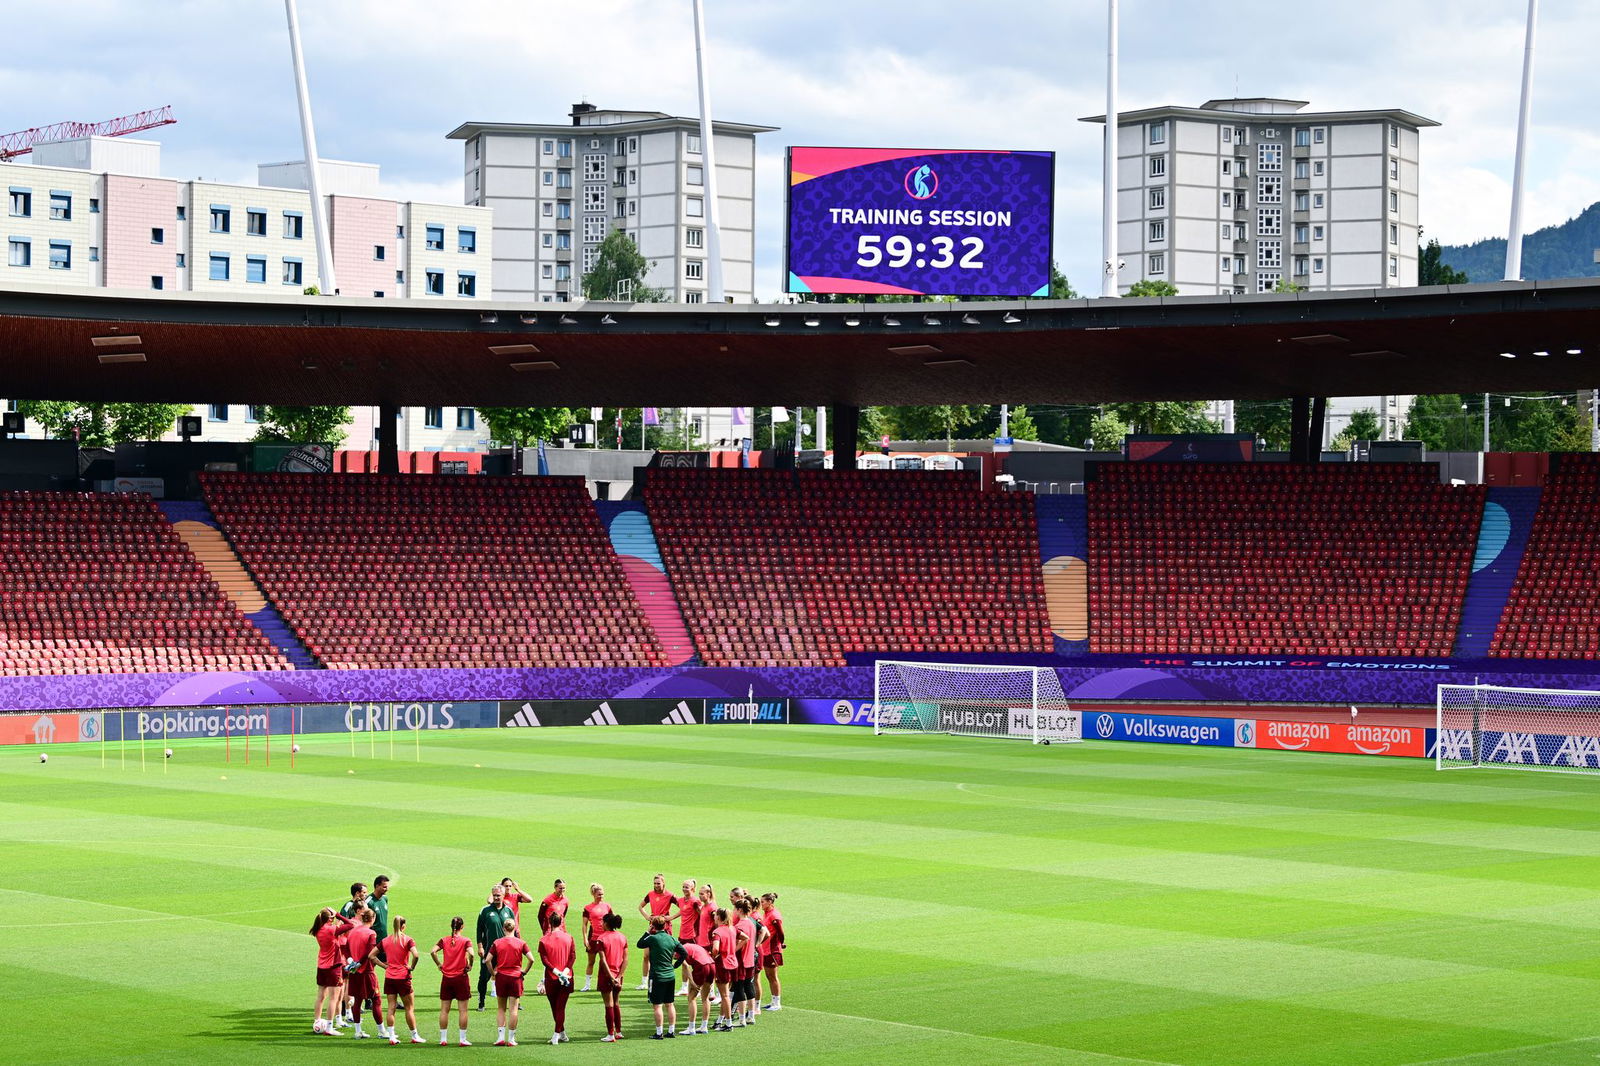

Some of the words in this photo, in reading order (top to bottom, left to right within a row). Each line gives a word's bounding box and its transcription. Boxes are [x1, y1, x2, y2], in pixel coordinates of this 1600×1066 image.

[829, 208, 923, 225] TRAINING
[928, 210, 1012, 227] SESSION
[856, 235, 984, 269] 59:32
[289, 450, 328, 473] Heineken
[1326, 661, 1450, 670] EMOTIONS
[344, 703, 455, 732] GRIFOLS
[711, 703, 782, 720] #FOOTBALL
[836, 705, 850, 714] EA
[943, 711, 1003, 728] HUBLOT
[137, 711, 267, 737] Booking.com
[1122, 718, 1220, 743] Volkswagen
[1268, 722, 1330, 739] amazon
[1347, 725, 1411, 744] amazon
[1489, 732, 1541, 764] AXA
[1550, 736, 1600, 768] AXA
